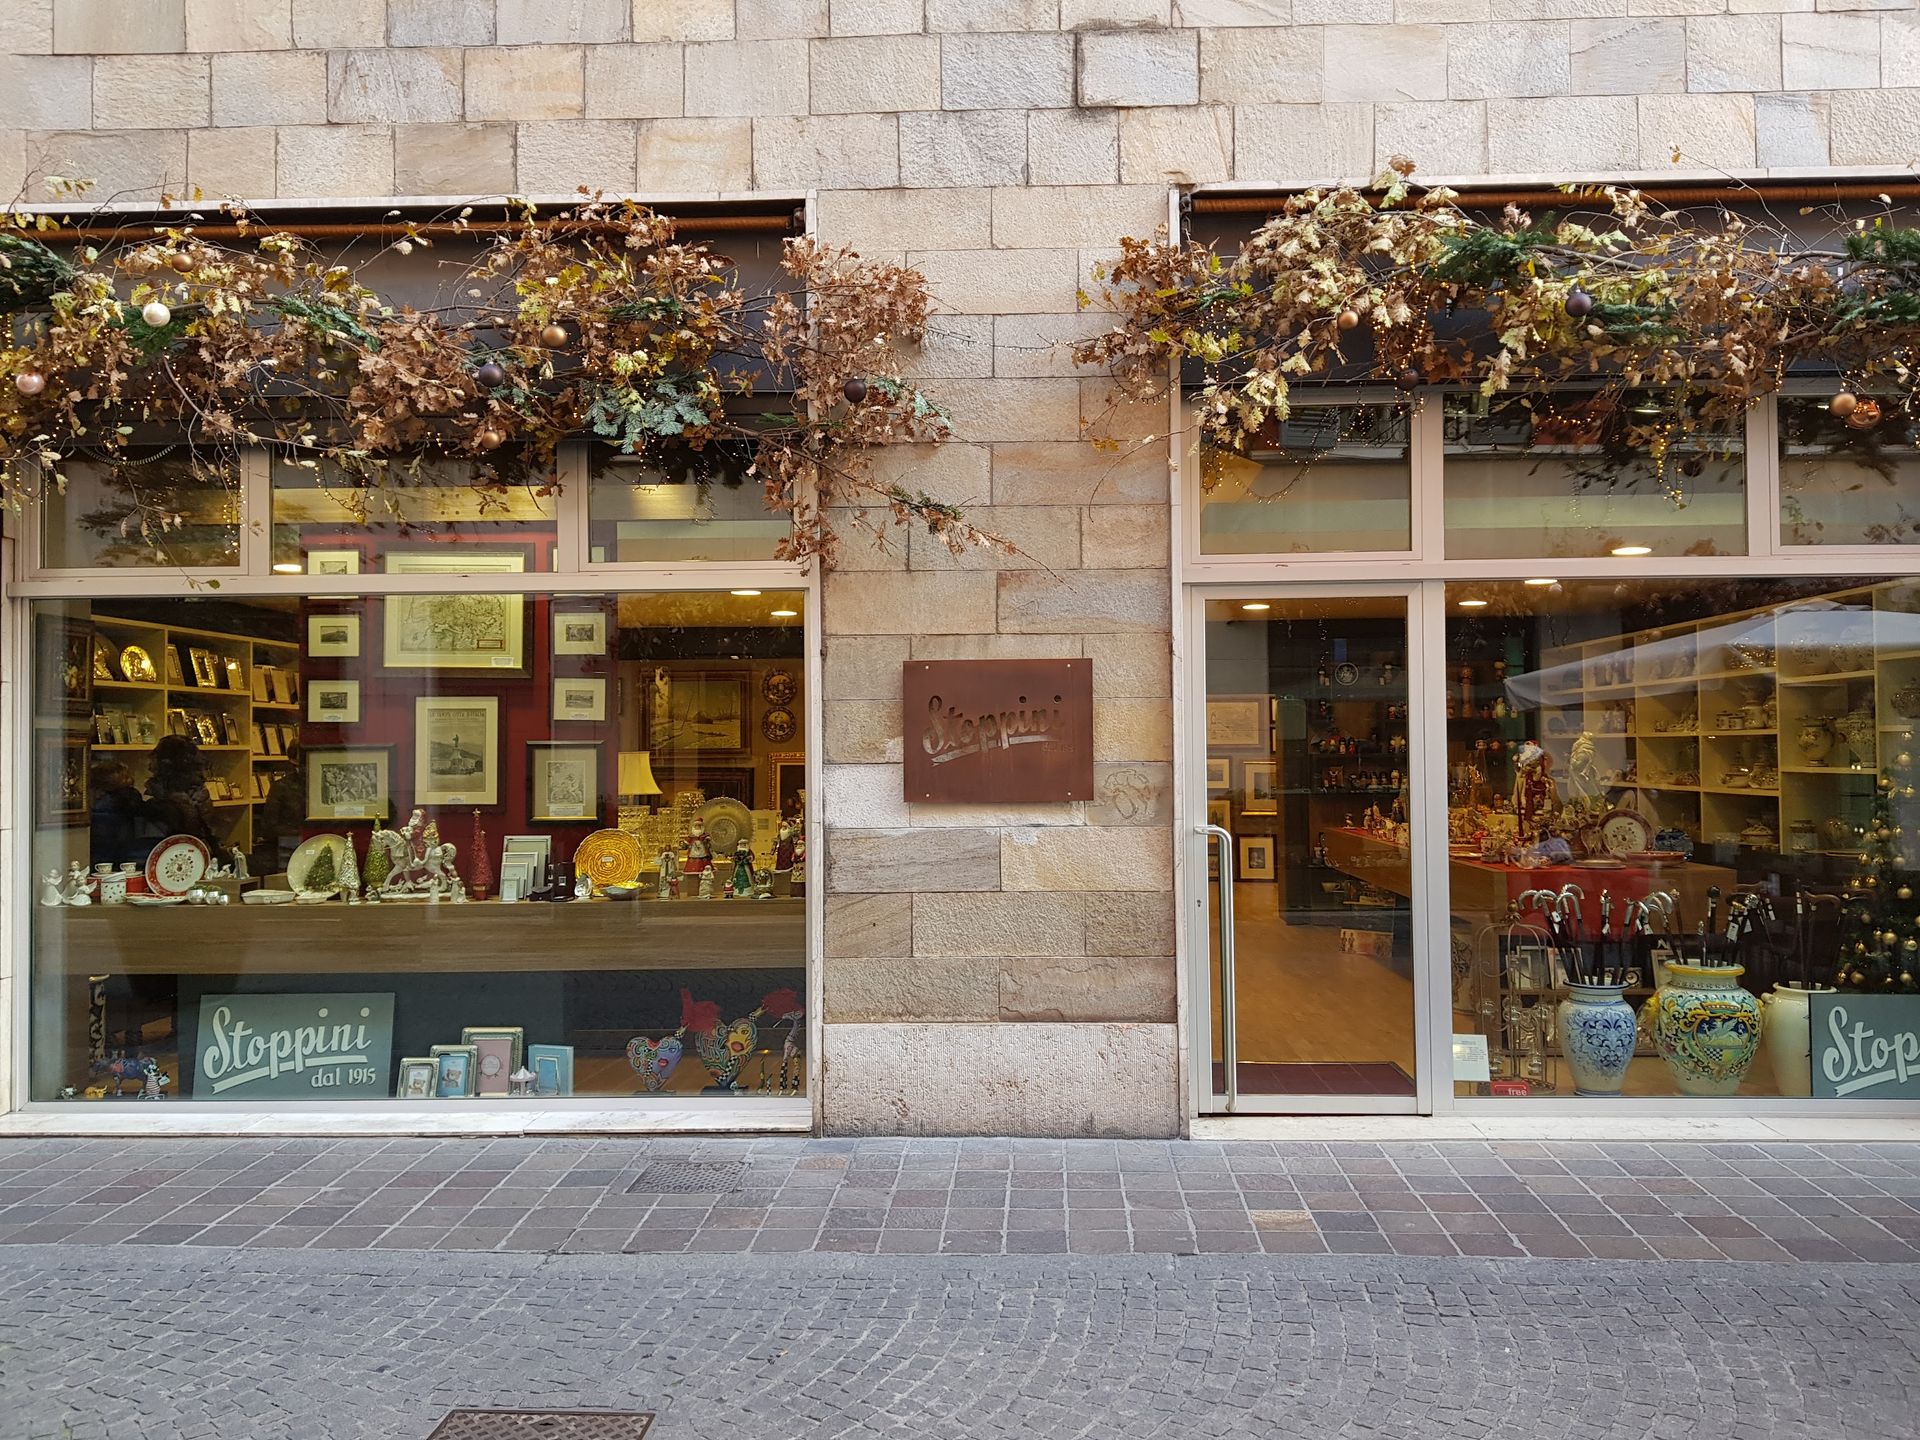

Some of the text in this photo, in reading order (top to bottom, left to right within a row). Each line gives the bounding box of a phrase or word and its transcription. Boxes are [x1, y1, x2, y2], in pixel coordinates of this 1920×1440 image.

[922, 694, 1066, 755] Stoppini
[203, 1006, 372, 1080] Stoppini
[1822, 1005, 1920, 1084] Stop
[310, 1066, 377, 1088] dal 1915
